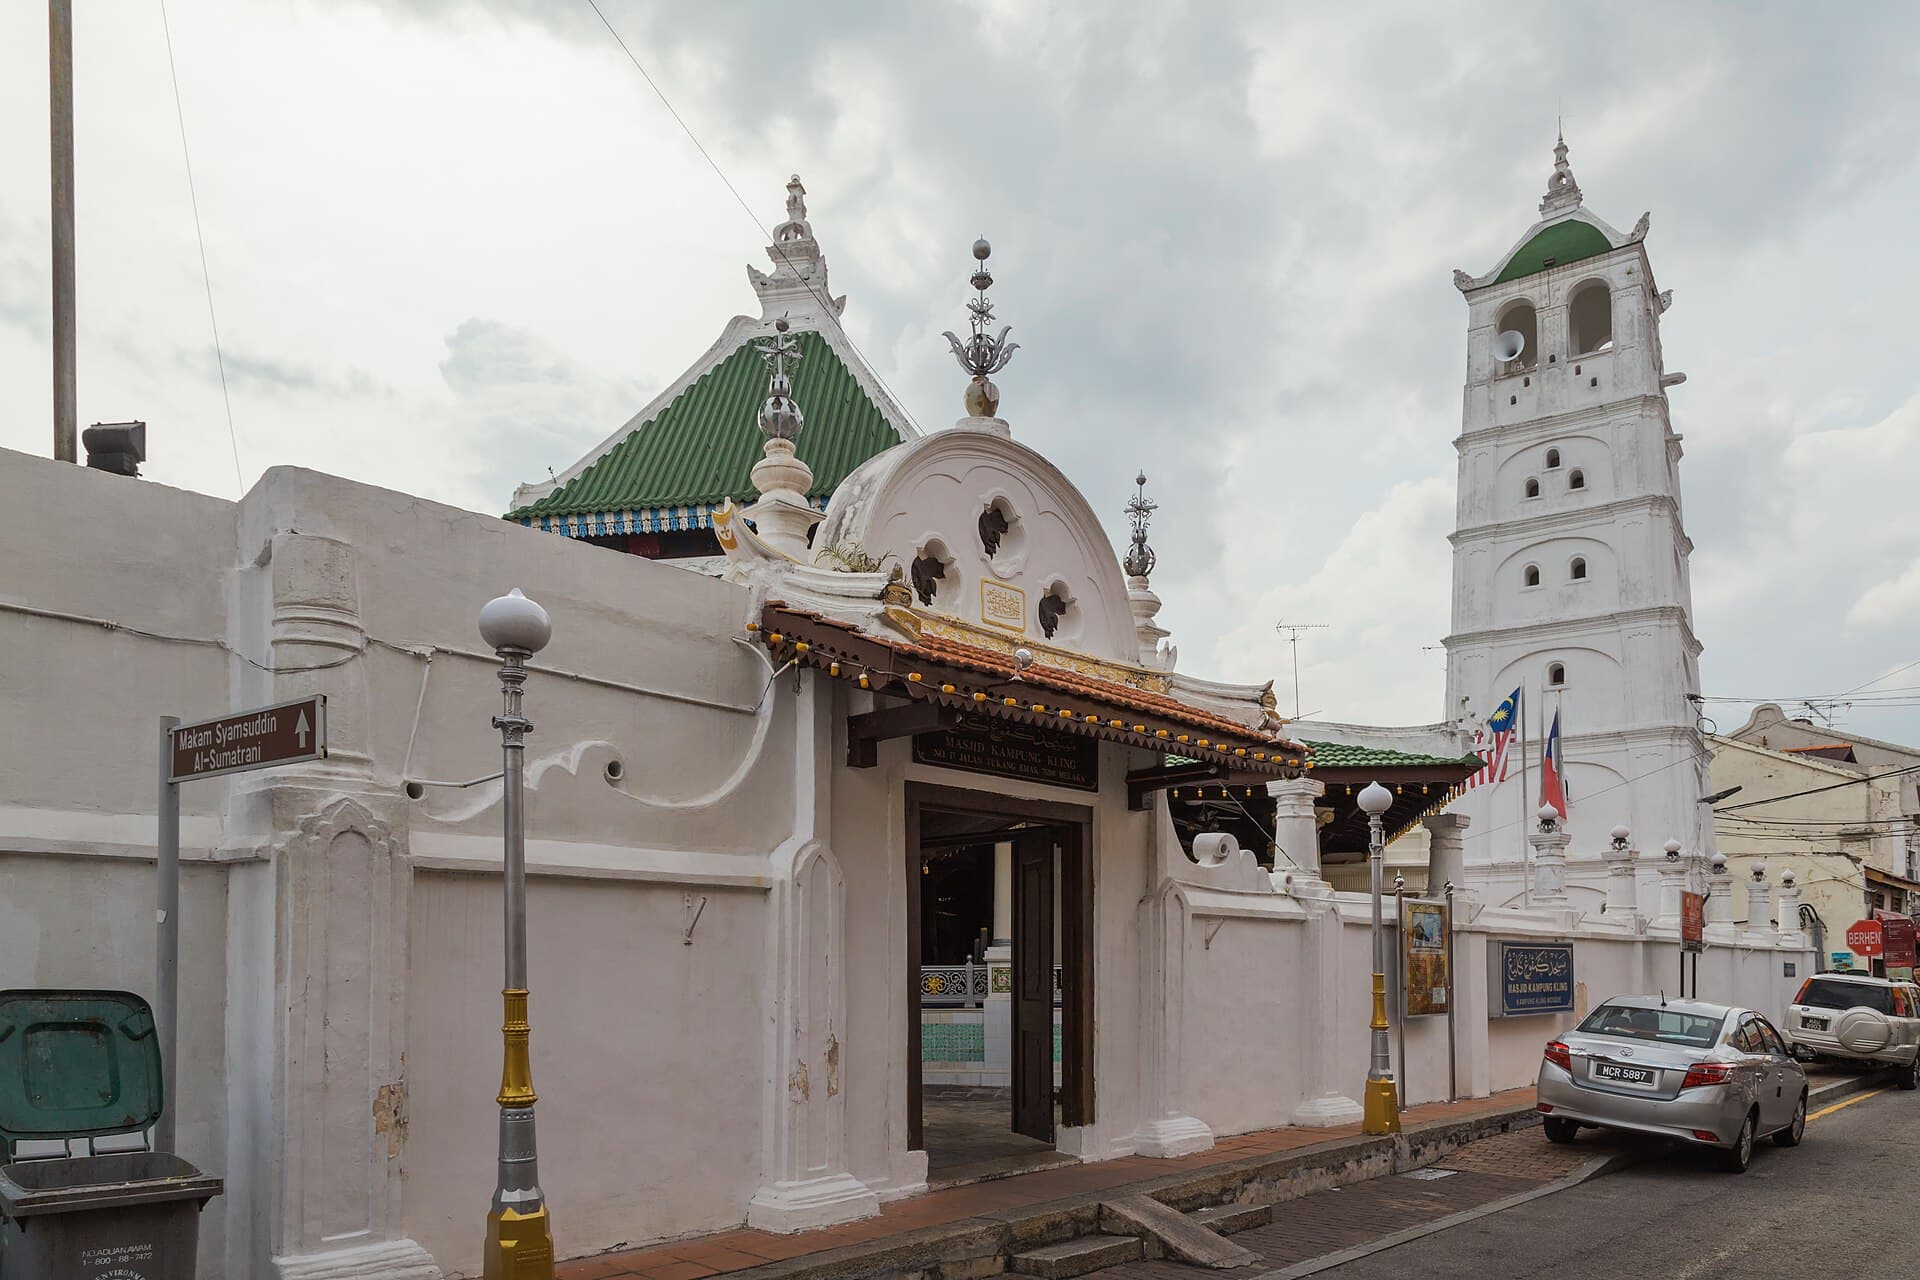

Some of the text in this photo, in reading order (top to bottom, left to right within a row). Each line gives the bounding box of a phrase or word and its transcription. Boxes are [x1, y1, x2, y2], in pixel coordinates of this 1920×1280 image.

[179, 713, 277, 750] Makam Syamsuddin
[194, 741, 261, 772] Al-Sumatrani
[945, 735, 1077, 770] MASJID KAMPUNG KLING
[959, 752, 983, 765] JALAN
[985, 758, 1016, 771] TUKANG
[1058, 770, 1087, 784] MELAKA
[1848, 931, 1882, 945] BERHEN
[1508, 982, 1568, 993] MASJID KAMPUNG KLING
[1602, 1066, 1647, 1080] MCR 5887
